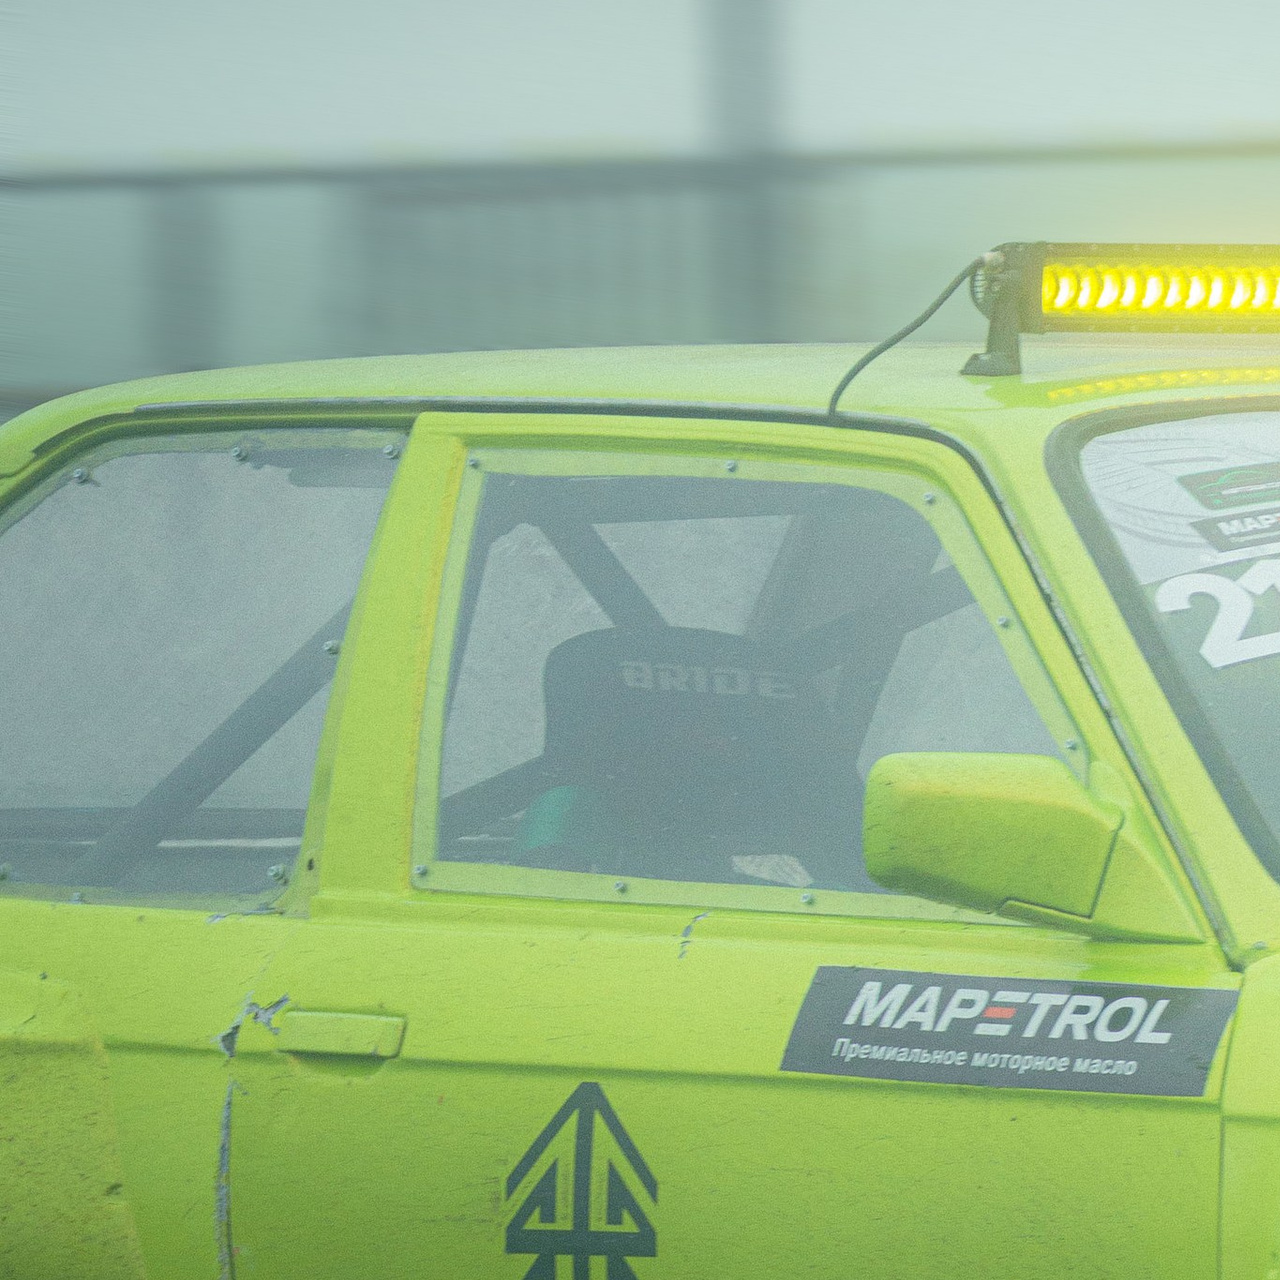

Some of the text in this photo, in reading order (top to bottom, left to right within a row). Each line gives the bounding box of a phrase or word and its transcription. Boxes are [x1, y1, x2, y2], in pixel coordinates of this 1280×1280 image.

[620, 660, 796, 699] BRIDE
[843, 980, 1173, 1044] MAPETROL
[832, 1037, 1138, 1076] Премиальное моторное масло
